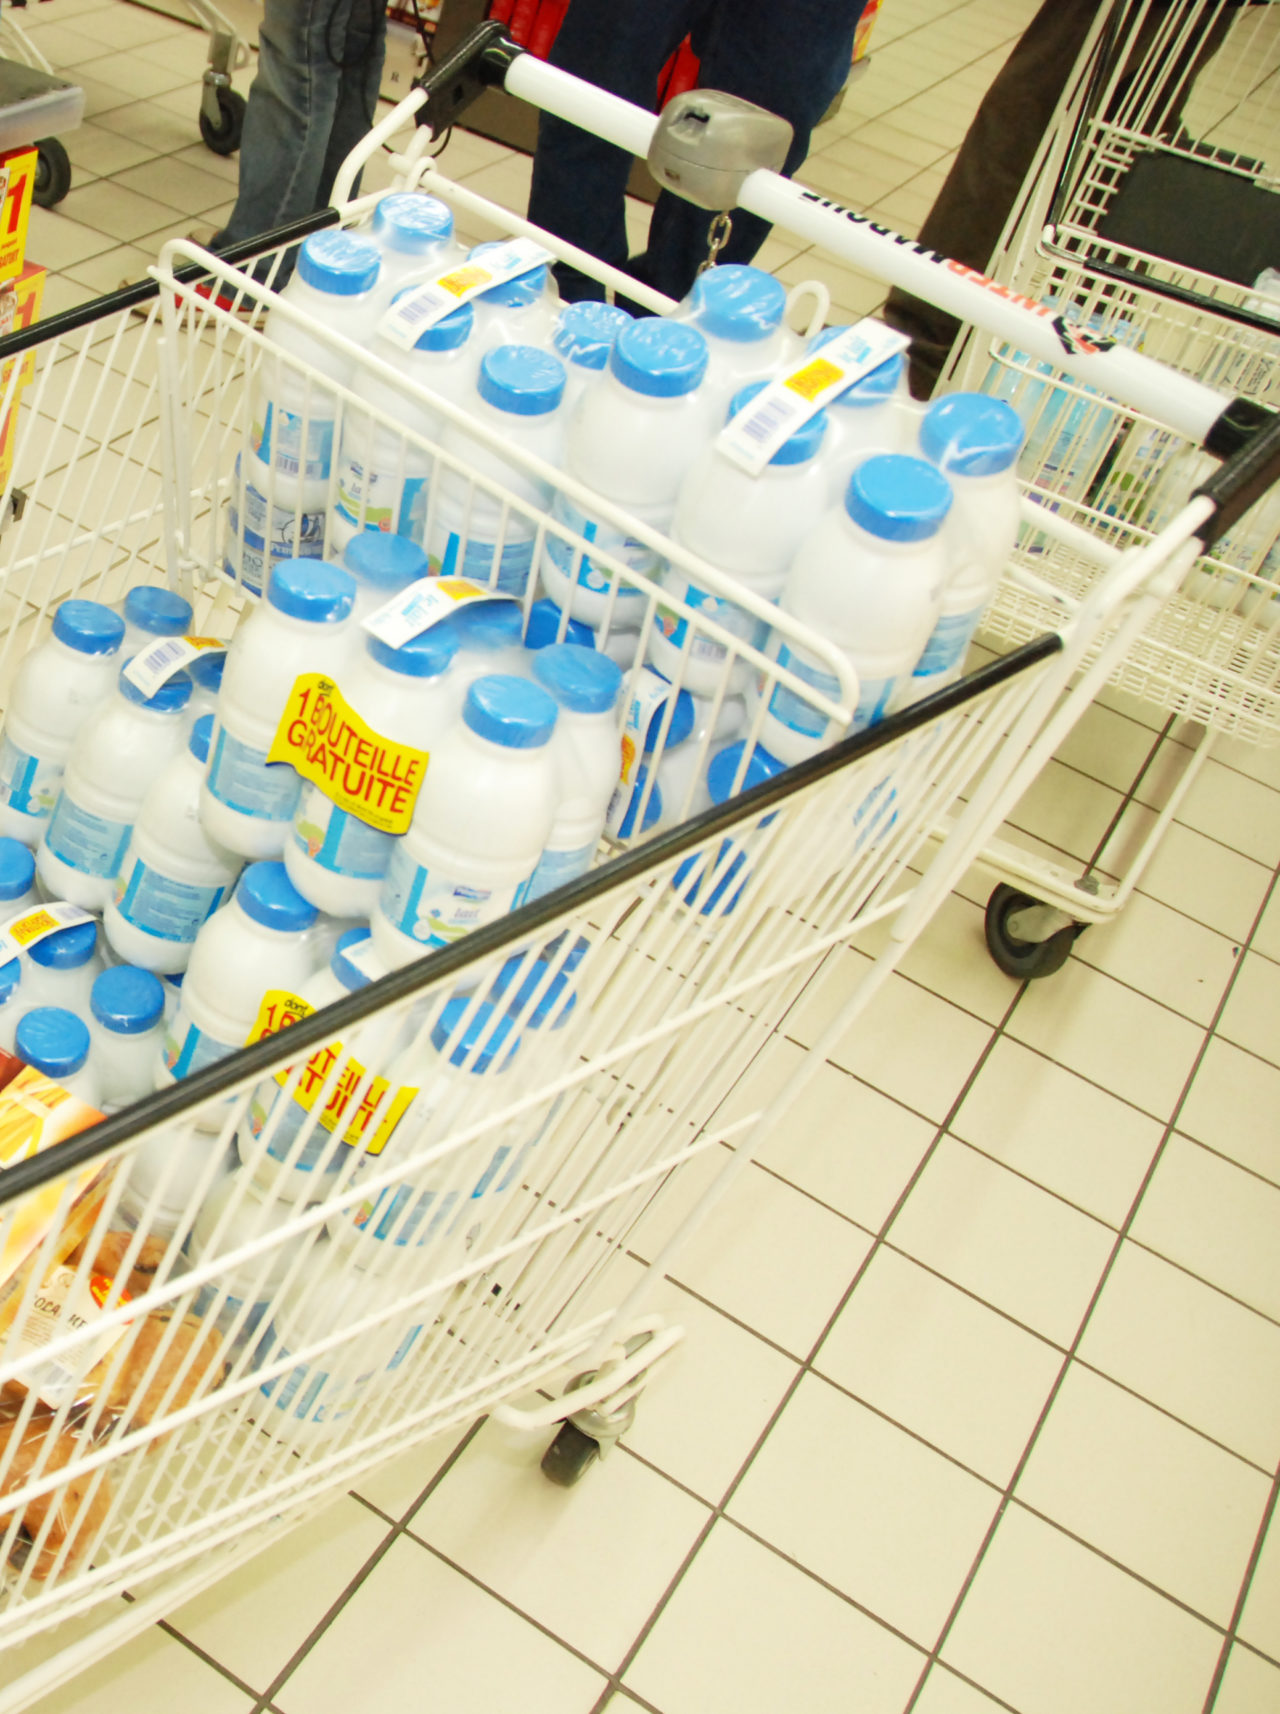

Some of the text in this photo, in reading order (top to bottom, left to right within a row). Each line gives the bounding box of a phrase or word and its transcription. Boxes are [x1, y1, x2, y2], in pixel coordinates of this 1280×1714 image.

[6, 173, 28, 235] 1
[287, 719, 414, 814] GRATUITE
[298, 687, 420, 787] 1 BOUTEILLE
